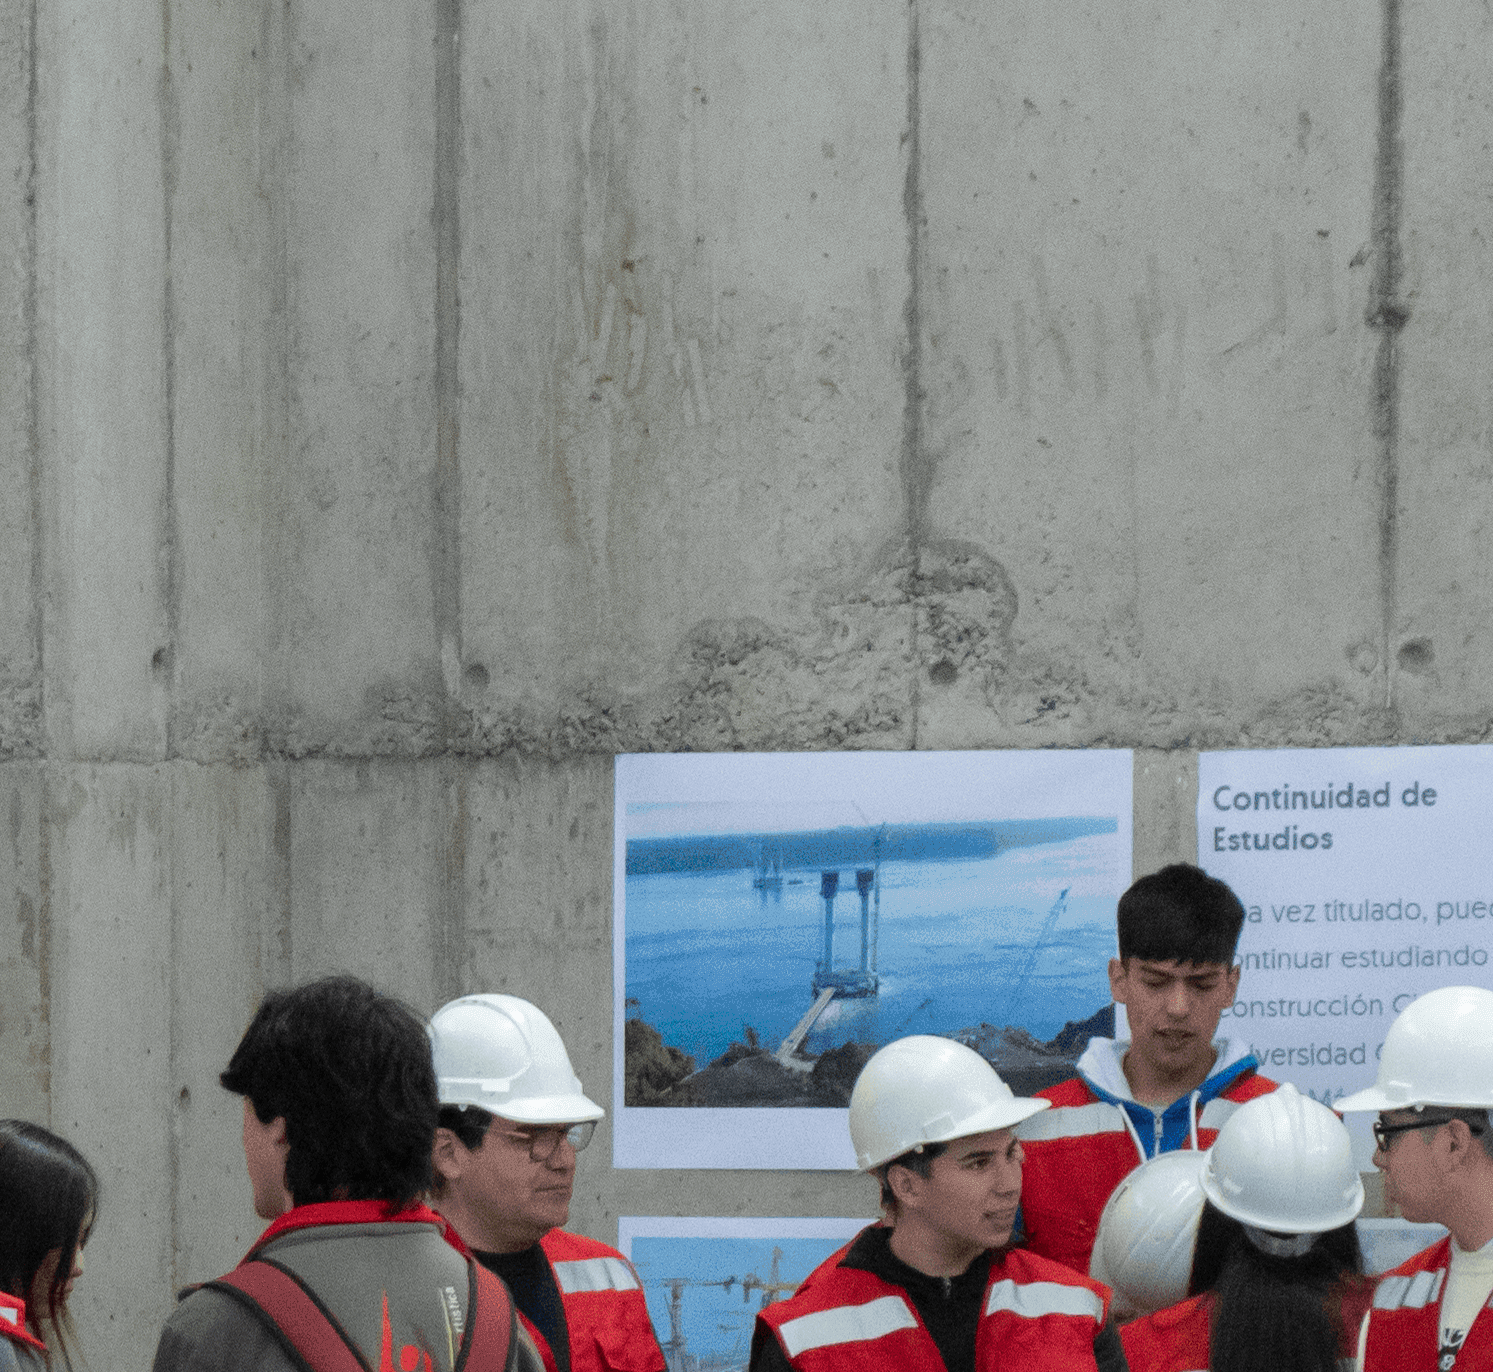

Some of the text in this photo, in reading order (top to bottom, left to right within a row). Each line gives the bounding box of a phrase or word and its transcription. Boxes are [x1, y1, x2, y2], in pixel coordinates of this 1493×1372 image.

[1213, 780, 1438, 812] Continuidad de
[1213, 824, 1334, 852] Estudios
[1272, 903, 1316, 923] vez
[1324, 898, 1428, 924] titulado,
[1237, 945, 1489, 970] ontinuar estudiando
[1249, 1042, 1367, 1067] iversidad
